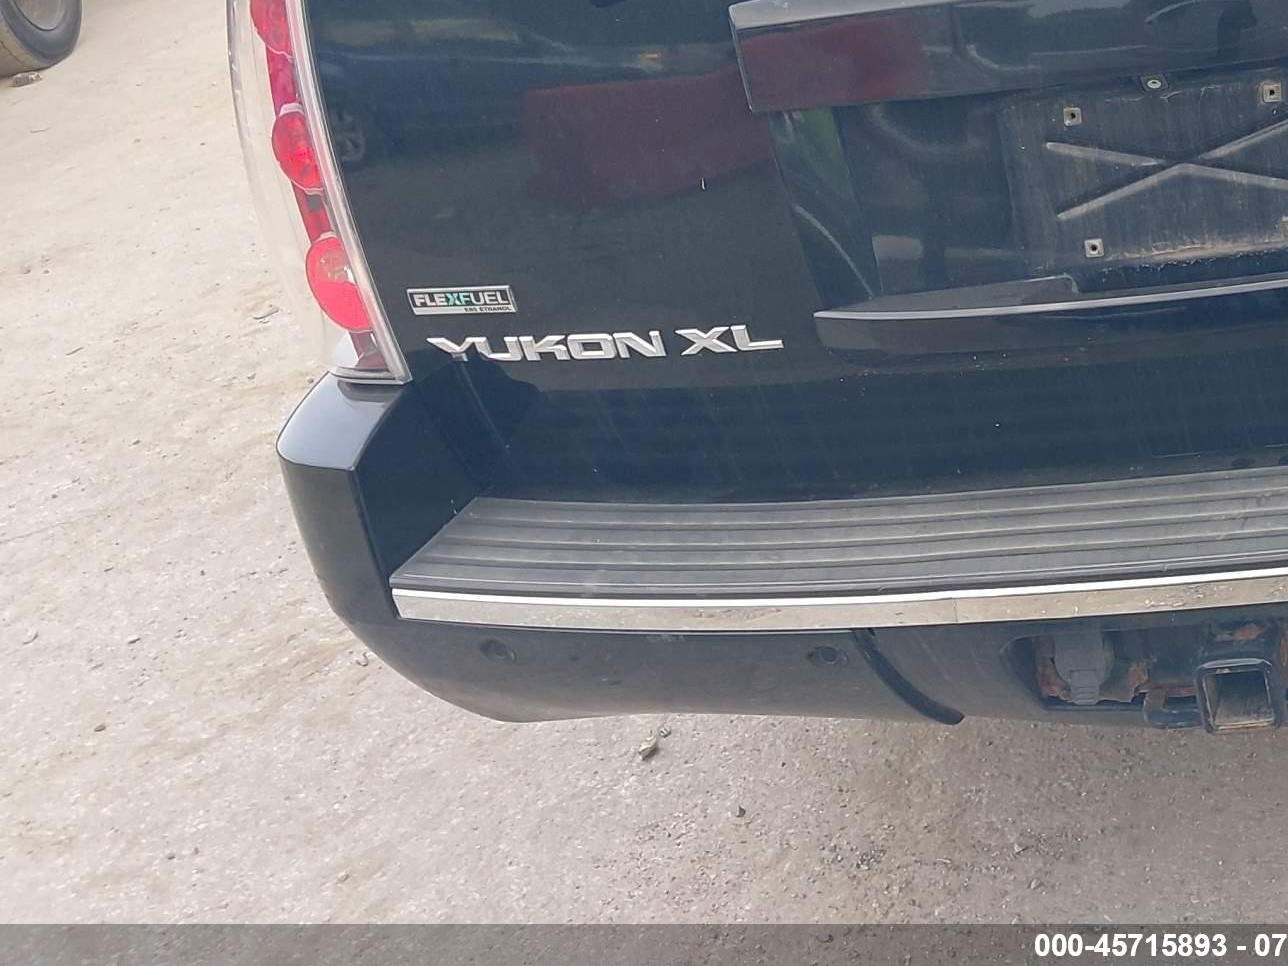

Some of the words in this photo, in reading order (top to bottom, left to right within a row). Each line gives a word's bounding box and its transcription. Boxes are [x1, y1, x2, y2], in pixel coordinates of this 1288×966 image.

[412, 291, 510, 307] FLEXFUEL
[426, 329, 667, 362] YUKON
[675, 324, 784, 356] XL
